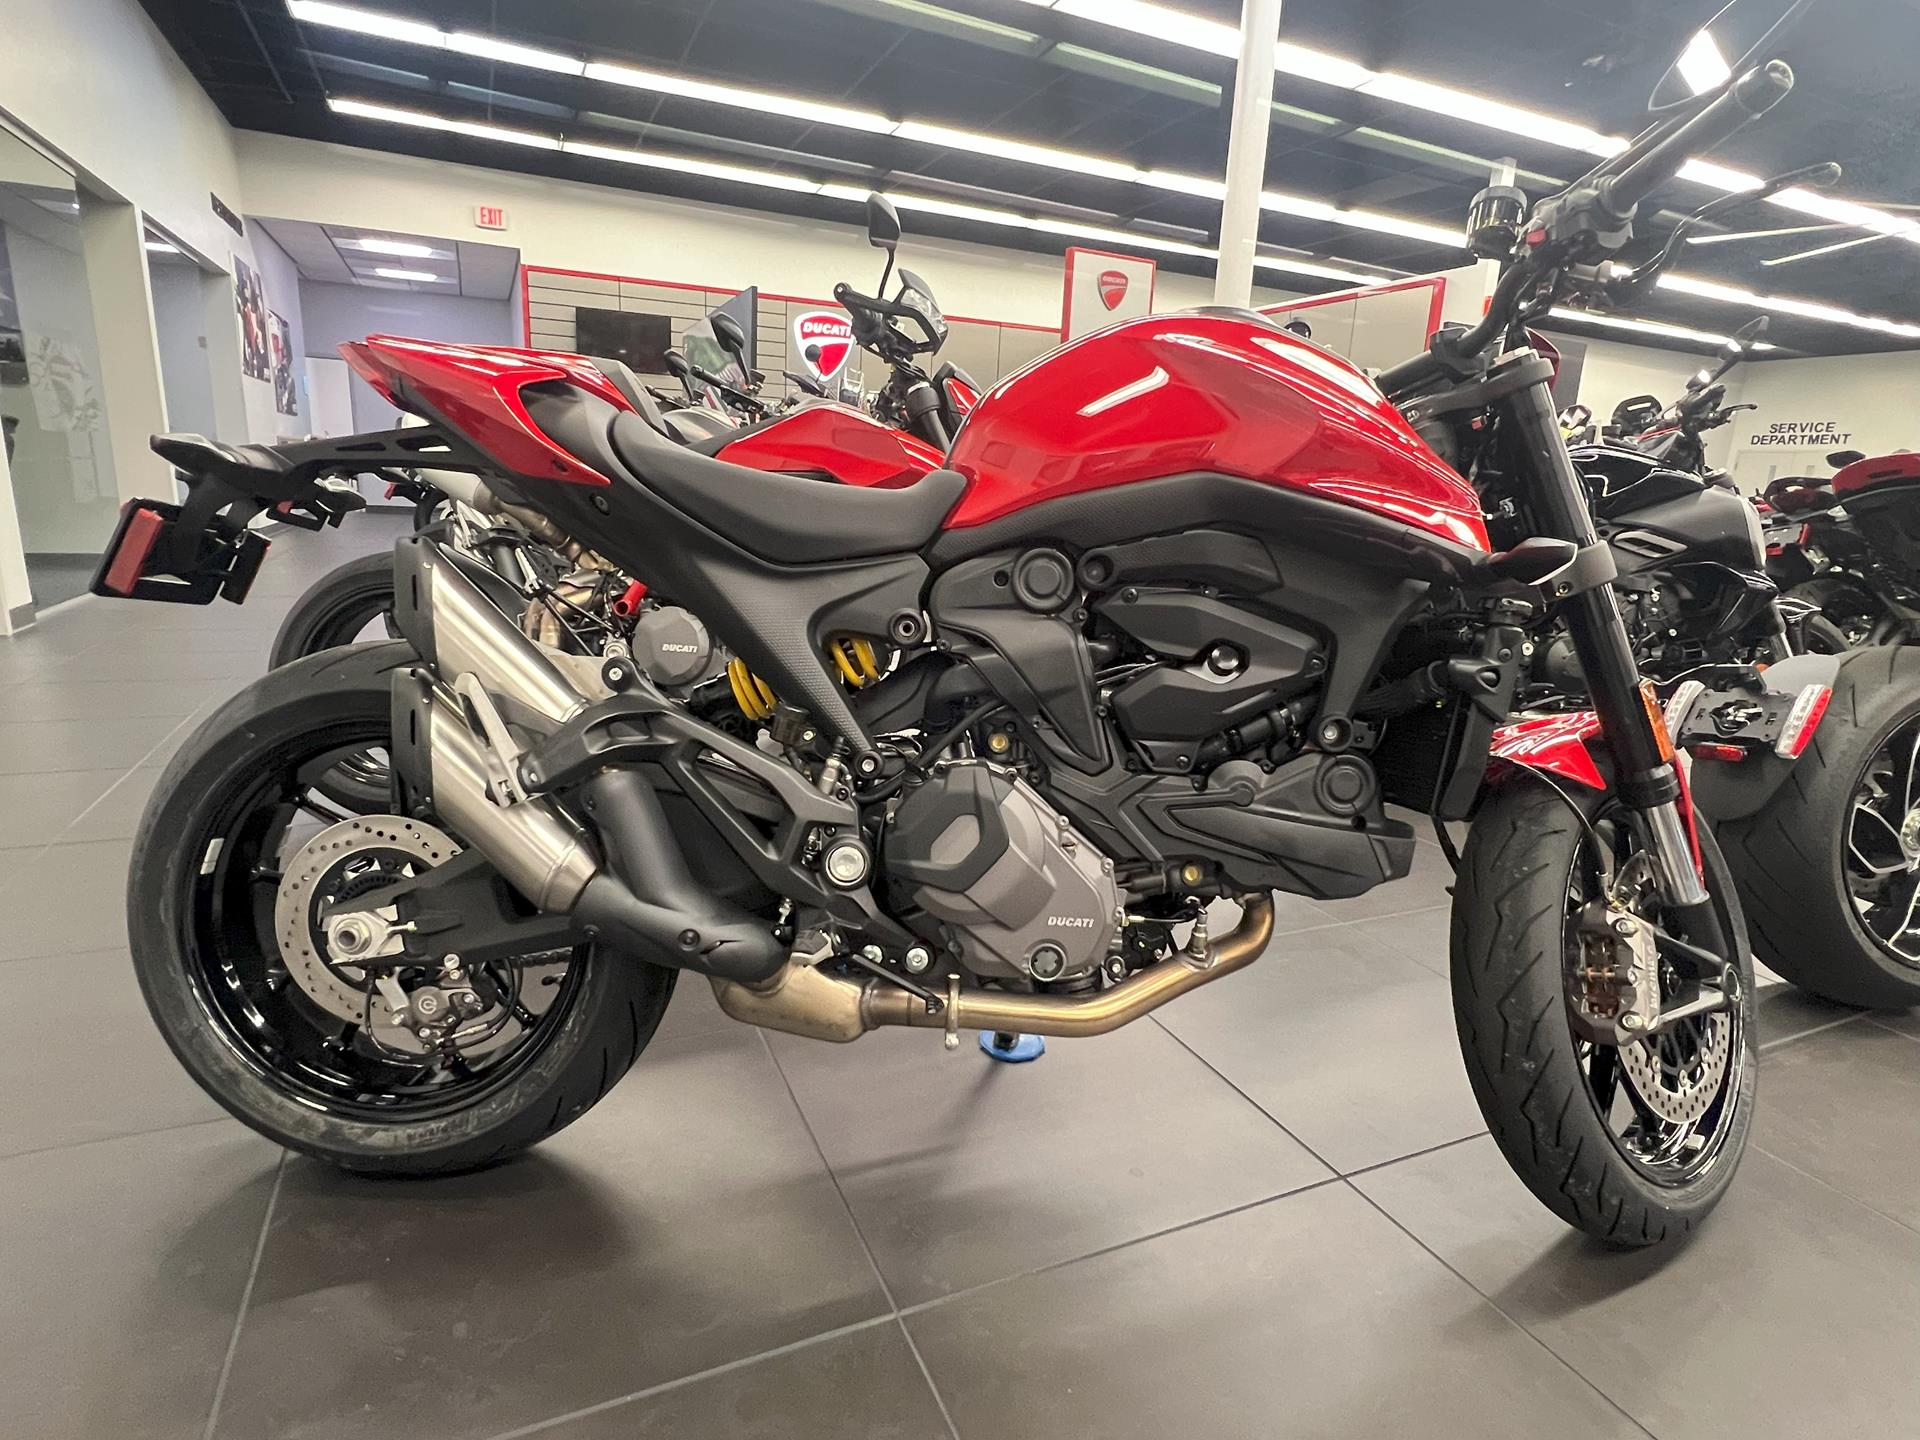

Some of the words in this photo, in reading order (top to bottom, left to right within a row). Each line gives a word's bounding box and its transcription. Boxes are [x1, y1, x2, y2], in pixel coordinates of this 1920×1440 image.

[480, 206, 503, 226] EXIT
[802, 321, 851, 336] DUCATI
[1769, 422, 1836, 434] SERVICE
[1750, 433, 1852, 446] DEPARTMENT
[662, 643, 698, 653] DUCATI
[1047, 916, 1095, 928] DUCATI
